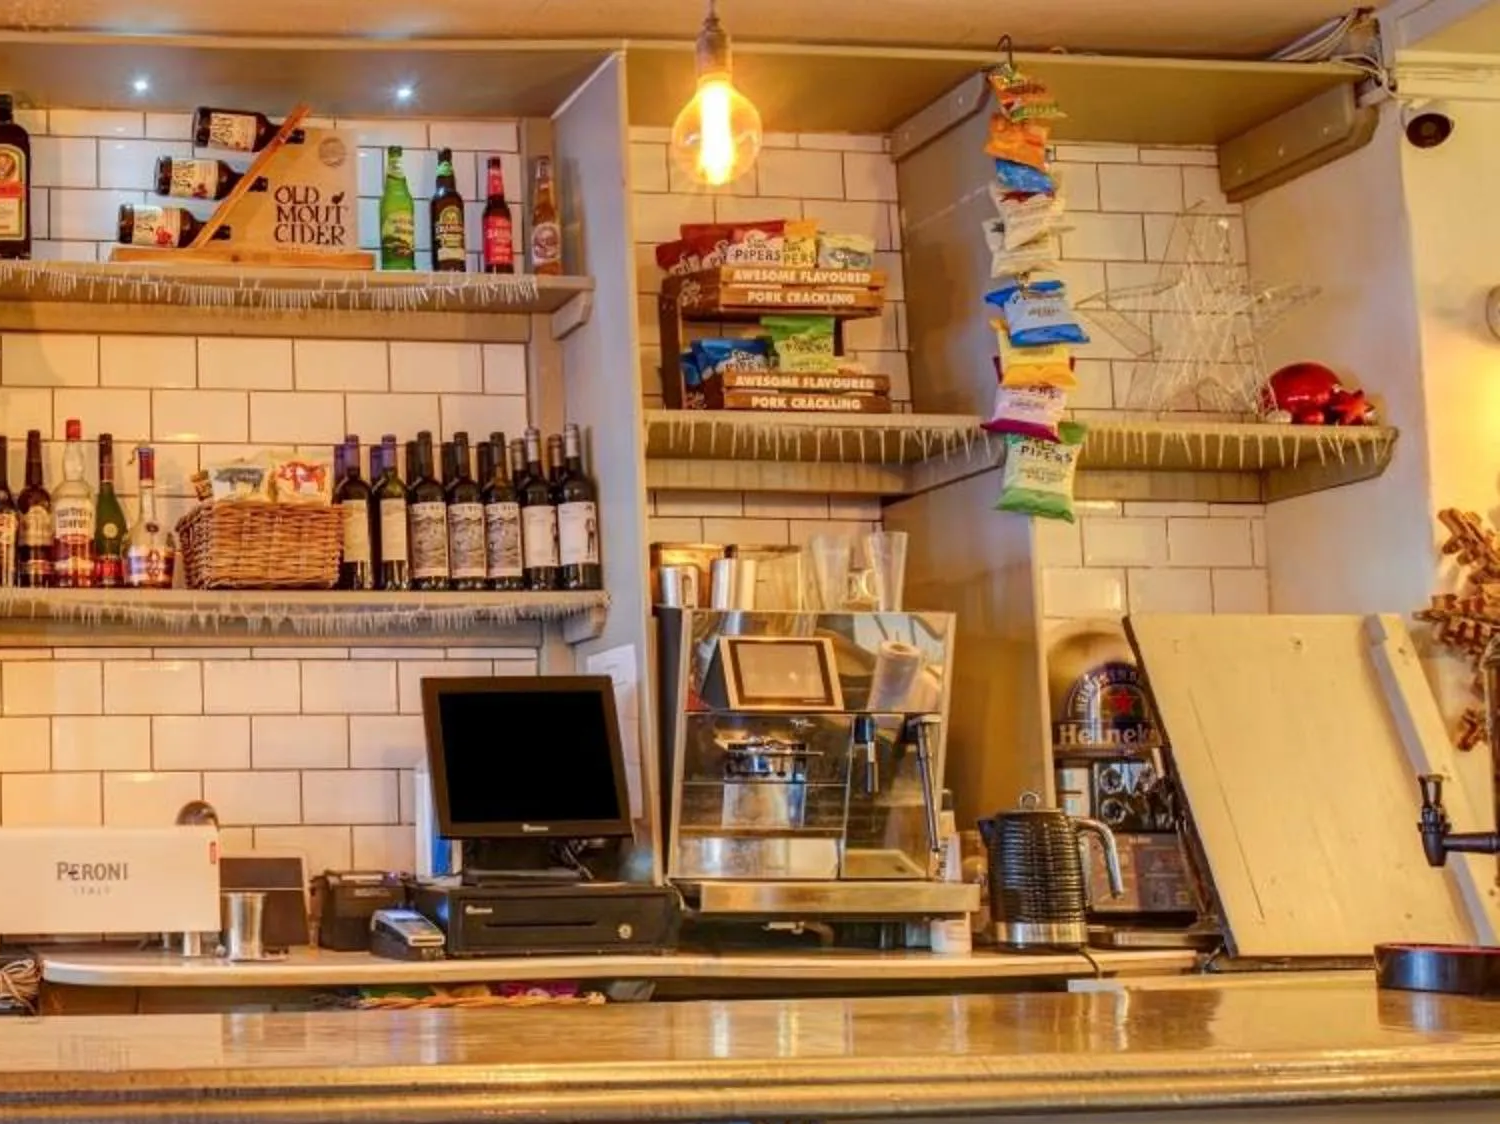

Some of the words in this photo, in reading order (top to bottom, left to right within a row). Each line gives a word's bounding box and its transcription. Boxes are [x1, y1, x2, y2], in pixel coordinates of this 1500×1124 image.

[273, 185, 319, 205] OLD
[275, 204, 345, 225] MOUT
[273, 224, 345, 246] CIDER
[735, 250, 781, 261] PIPERS
[733, 270, 796, 283] AWESOME
[800, 271, 871, 283] FLAVOURED
[748, 292, 782, 304] PORK
[787, 292, 855, 304] CRACKLING
[735, 375, 798, 388] AWESOME
[751, 398, 787, 409] PORK
[791, 398, 861, 410] CRACKLING
[56, 861, 129, 881] PERONI
